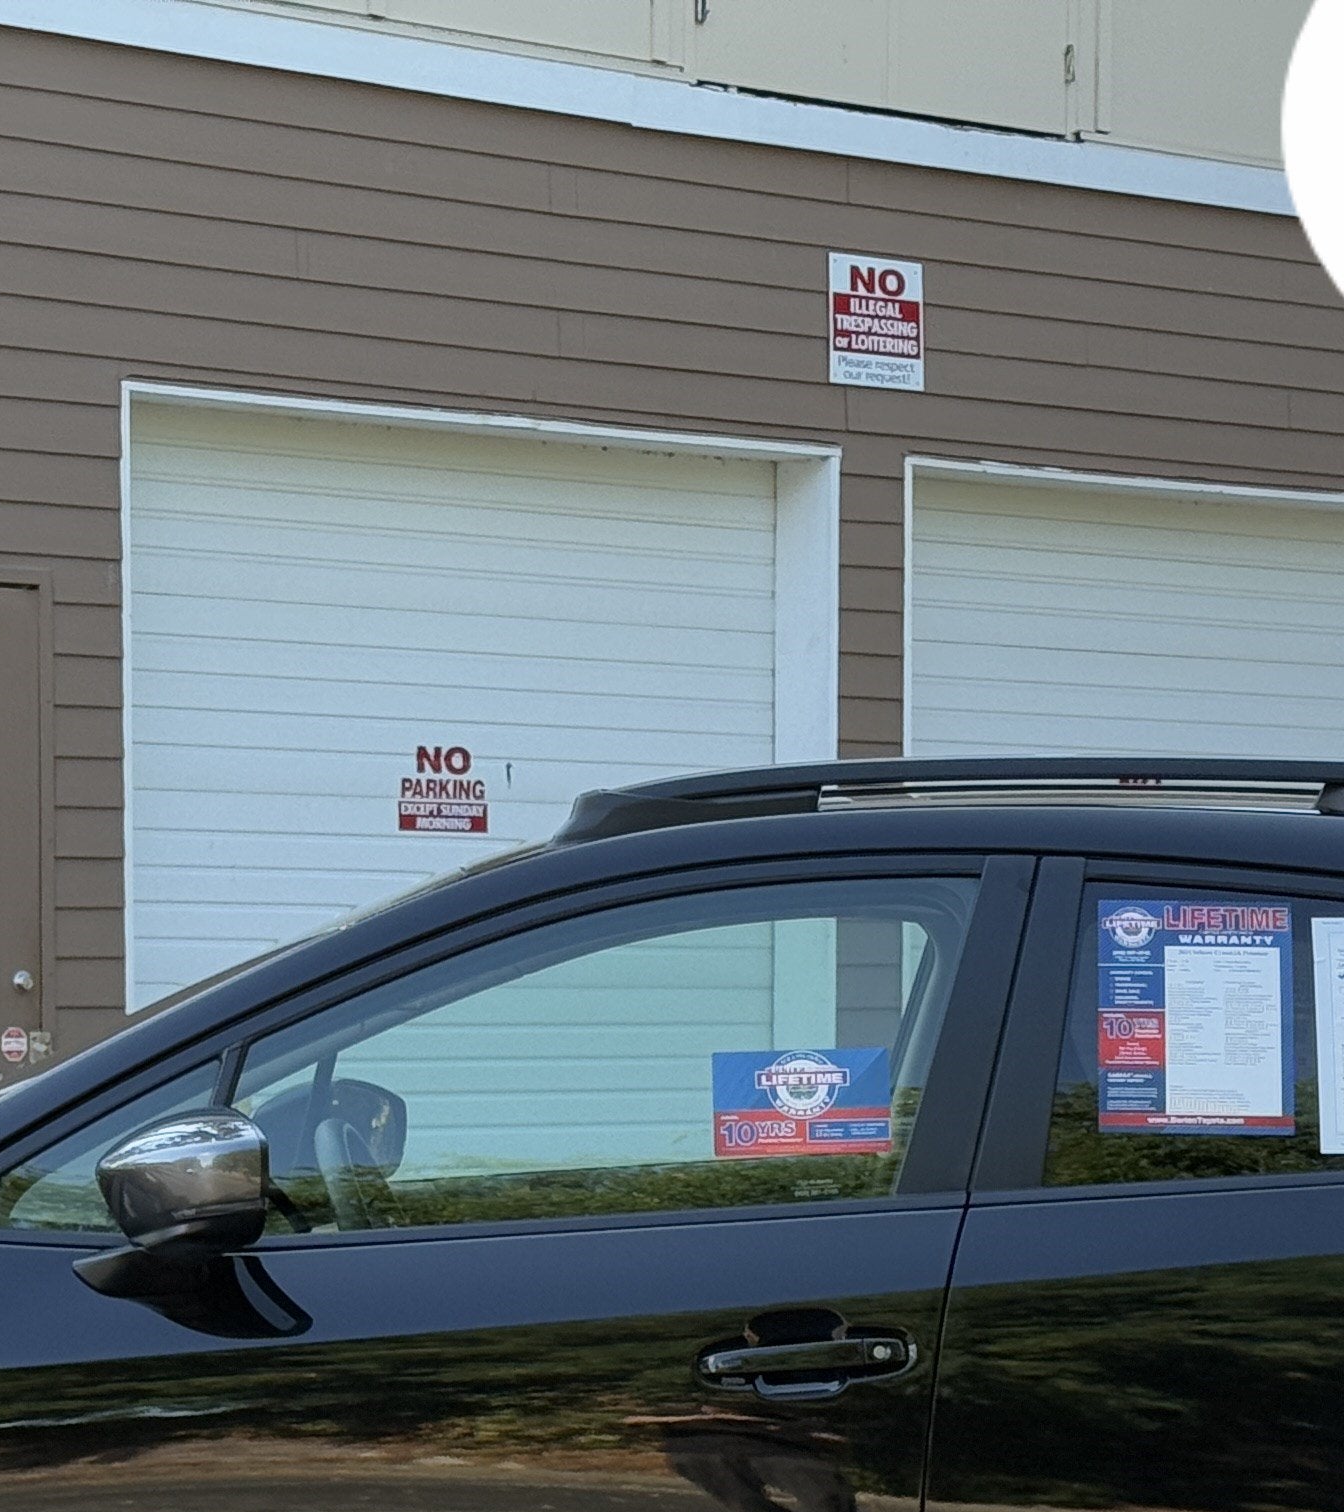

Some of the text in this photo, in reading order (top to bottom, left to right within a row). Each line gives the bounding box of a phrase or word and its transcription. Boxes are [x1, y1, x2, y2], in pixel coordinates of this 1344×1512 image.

[849, 265, 906, 297] NO
[849, 298, 904, 318] ILLEGAL
[835, 314, 918, 338] TRESPASSING
[835, 333, 919, 356] or LOITERING
[837, 355, 916, 374] Please respect
[843, 370, 863, 381] our
[416, 745, 472, 775] NO
[401, 777, 486, 800] PARKING
[400, 803, 485, 817] EXCEPT SUNDAY
[415, 817, 473, 830] MORNING
[1164, 905, 1289, 931] LIFETIME
[1178, 934, 1274, 946] WARRANTY
[1103, 1017, 1134, 1039] 10
[760, 1073, 844, 1085] LIFETIME
[775, 1095, 831, 1116] WARRANTY
[720, 1121, 756, 1147] 10
[755, 1121, 797, 1137] YRS
